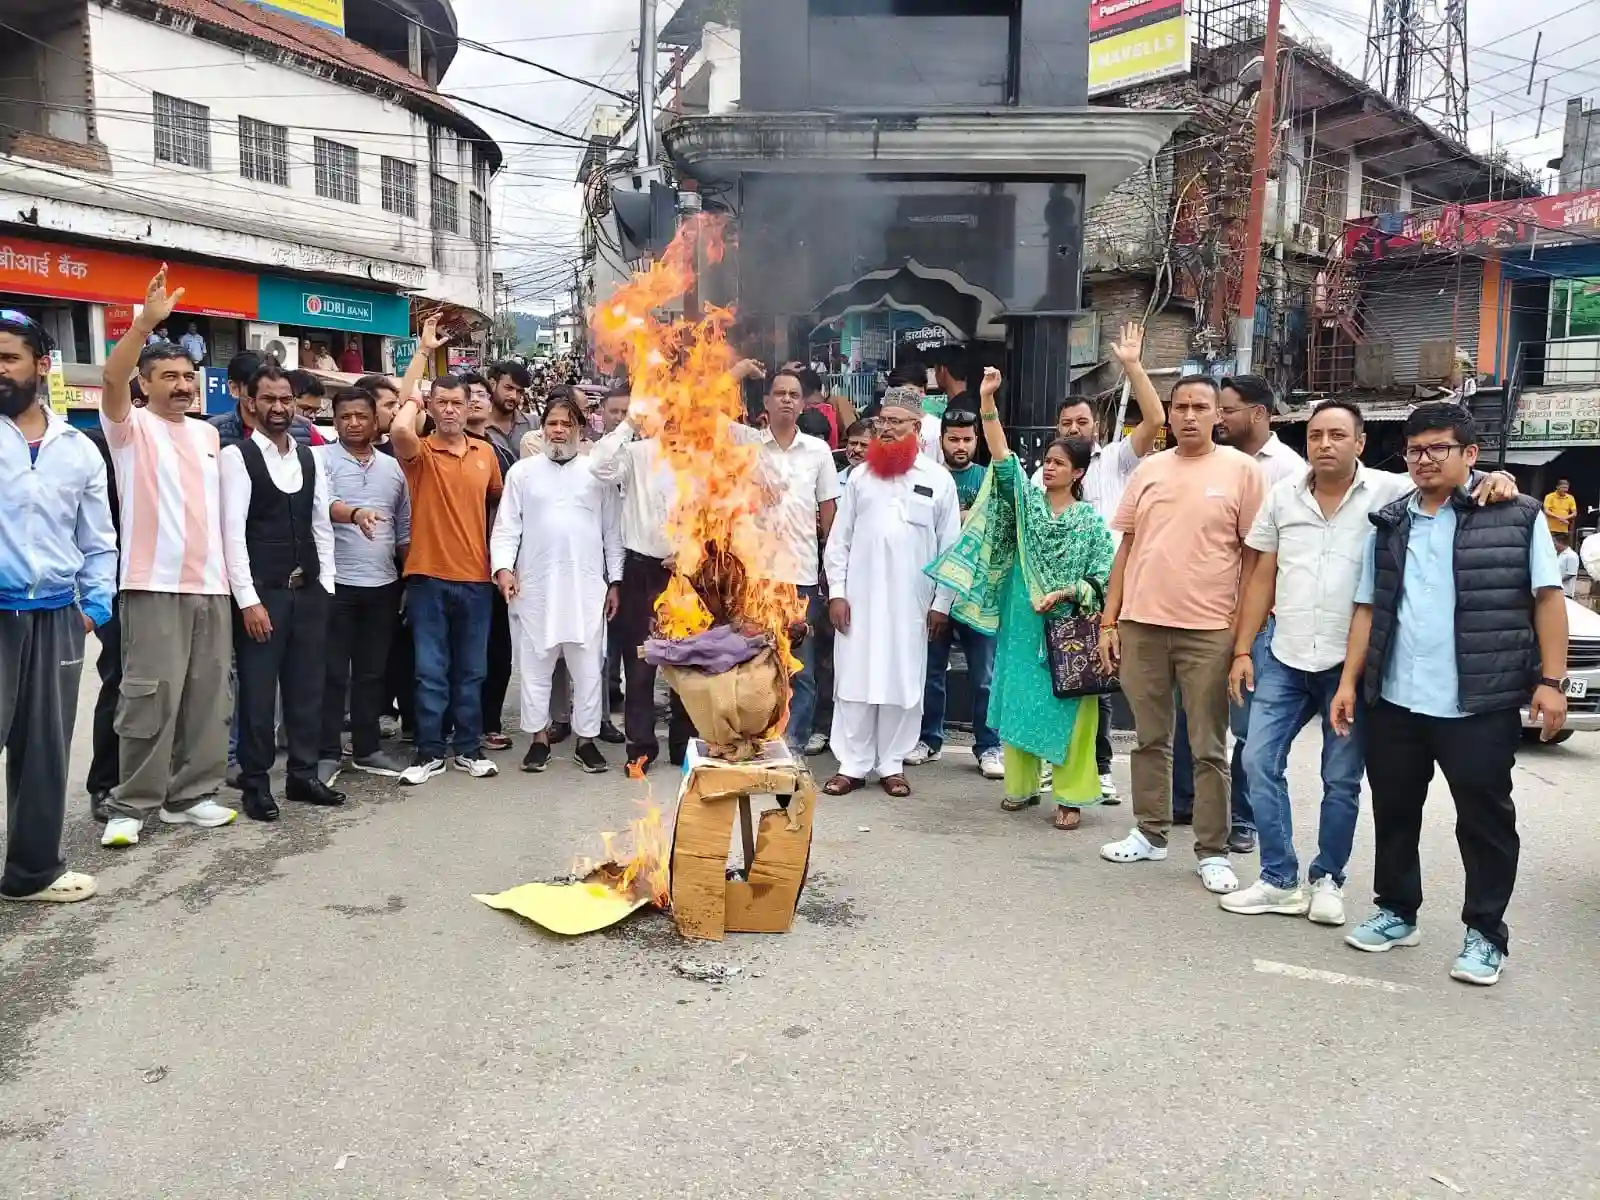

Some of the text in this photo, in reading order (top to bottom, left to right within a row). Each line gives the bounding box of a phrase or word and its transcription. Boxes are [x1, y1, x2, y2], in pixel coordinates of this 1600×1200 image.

[1097, 34, 1176, 67] HAVELLS
[58, 252, 88, 280] बैंक
[323, 300, 369, 318] IDBI BANK
[397, 342, 417, 358] ATM
[209, 376, 226, 395] Fi
[65, 390, 81, 402] ALE
[1569, 681, 1585, 694] 63
